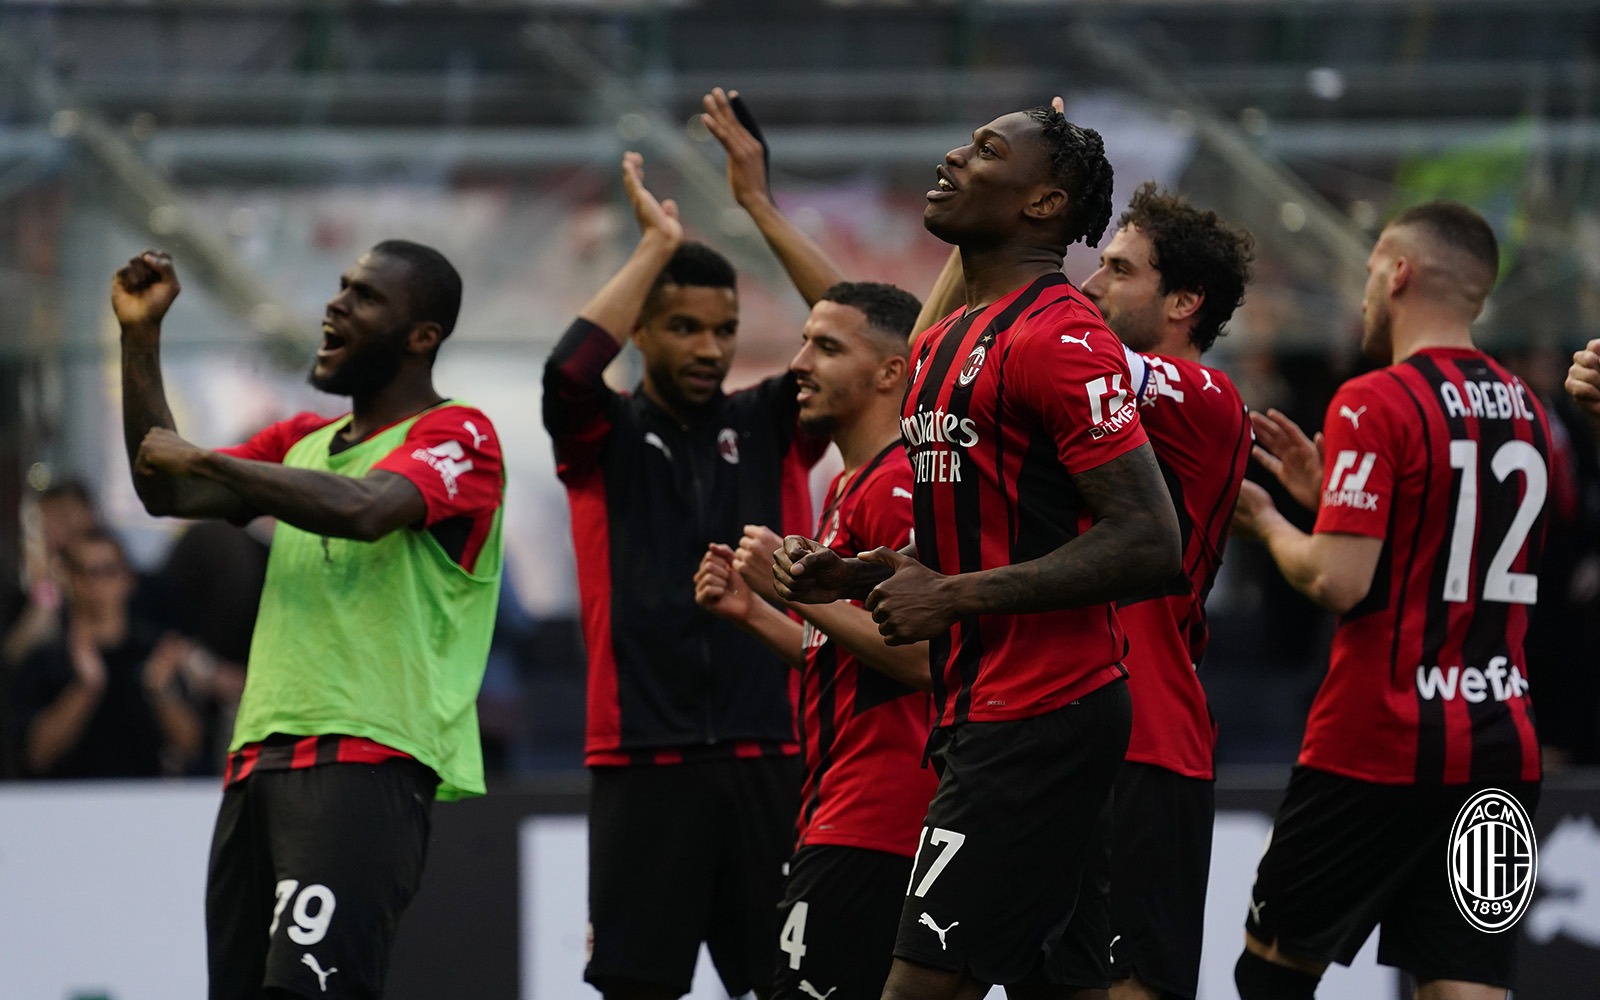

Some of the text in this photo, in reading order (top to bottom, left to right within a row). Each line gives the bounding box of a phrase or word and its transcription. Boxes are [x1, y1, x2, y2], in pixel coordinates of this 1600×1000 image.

[900, 403, 979, 448] mirates
[1443, 439, 1548, 605] 12
[268, 879, 337, 946] 79
[780, 901, 809, 971] 4
